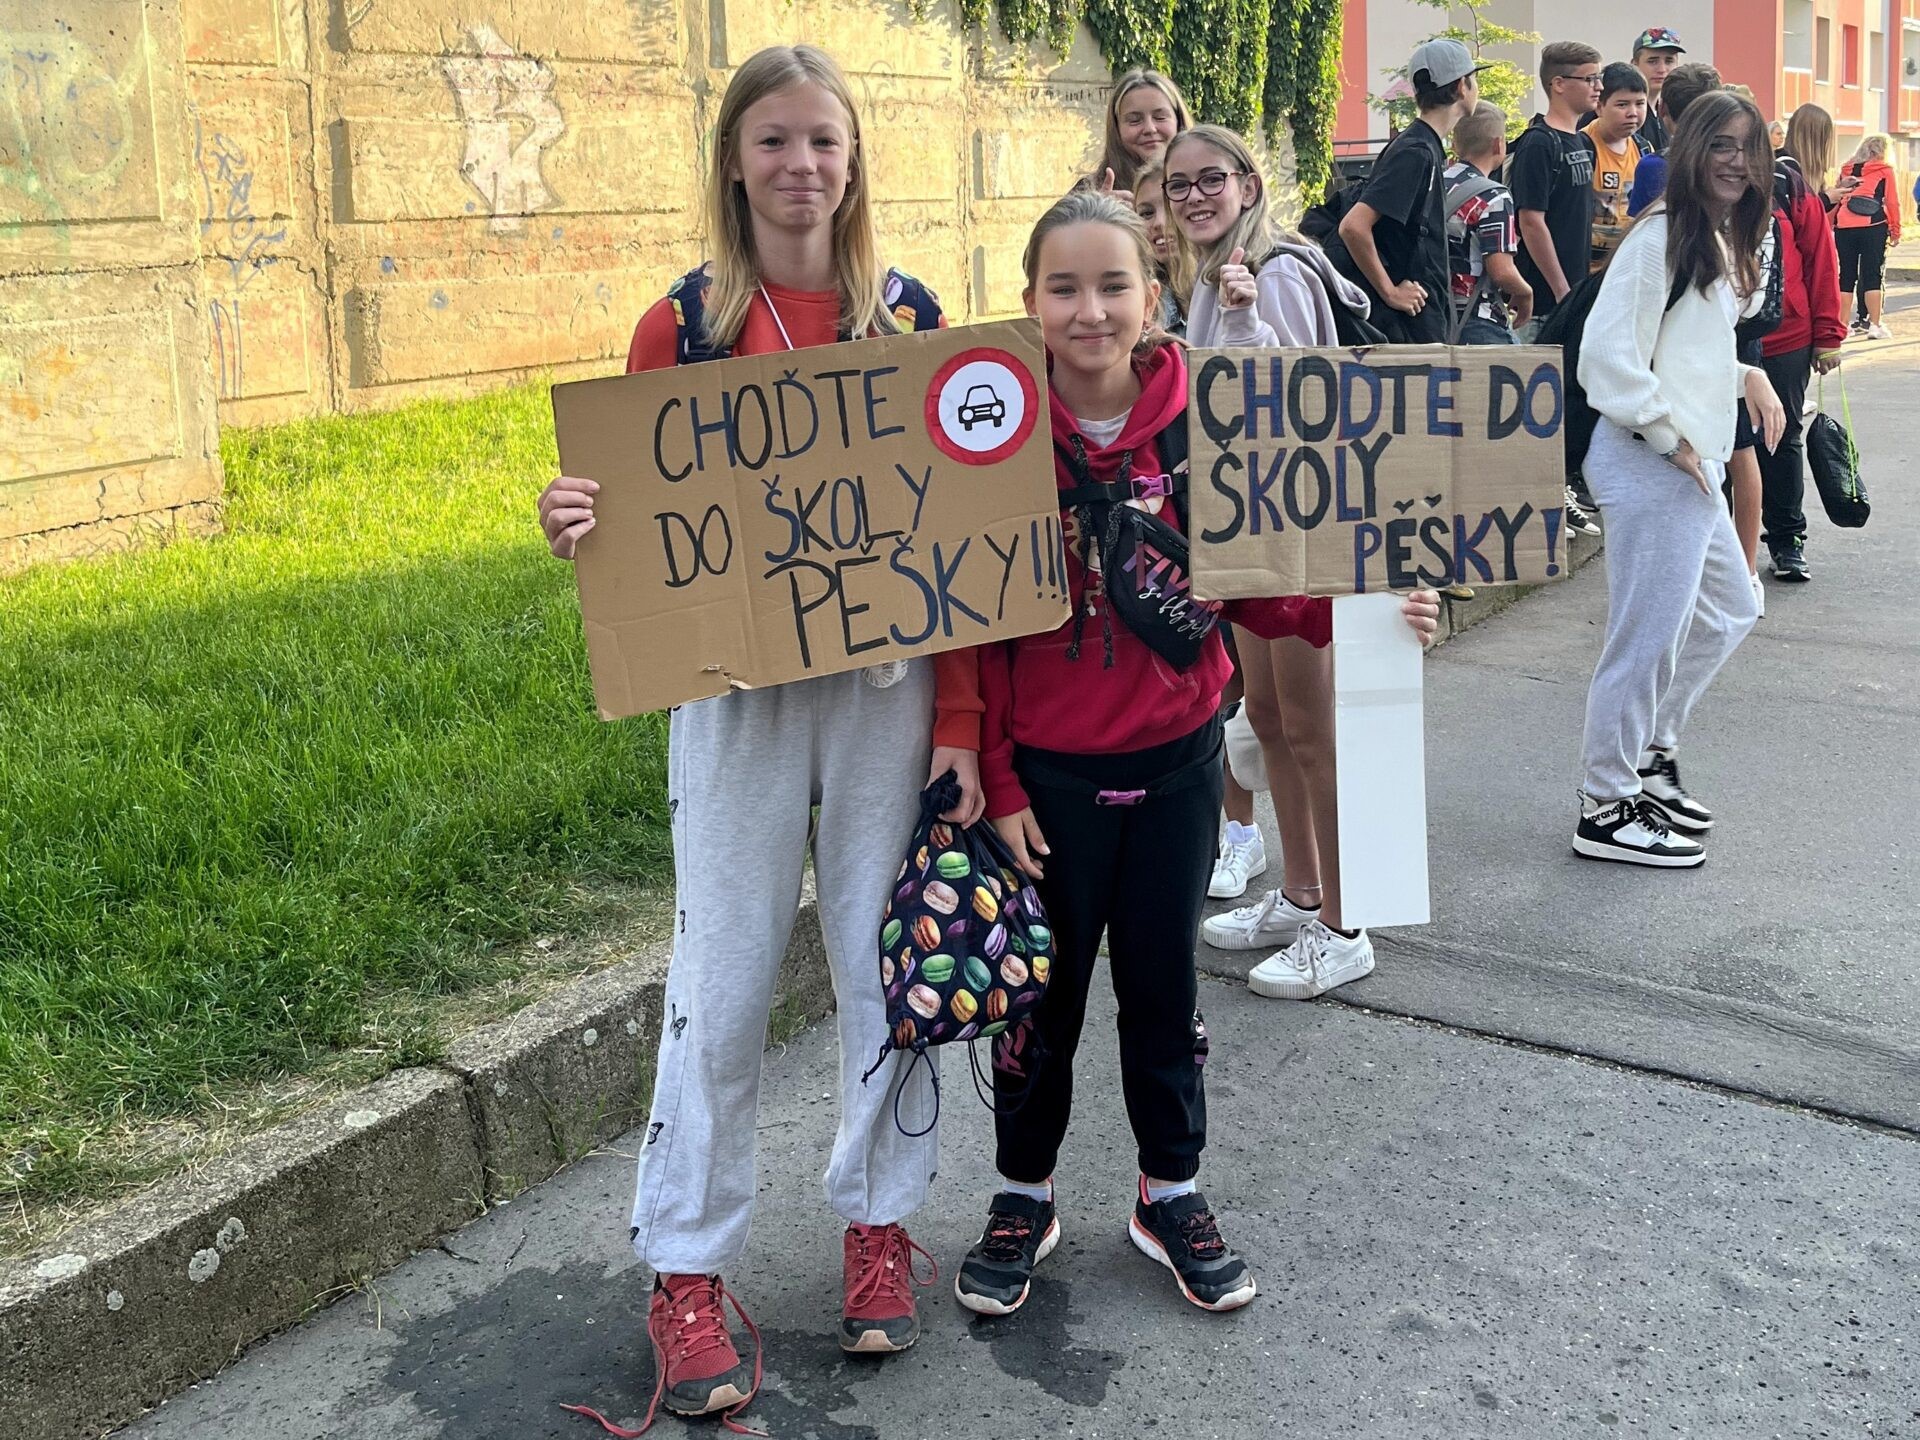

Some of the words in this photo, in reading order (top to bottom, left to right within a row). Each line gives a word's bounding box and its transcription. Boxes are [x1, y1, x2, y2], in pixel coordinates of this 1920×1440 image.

[653, 366, 905, 482] CHOĎTE
[1196, 348, 1463, 443] CHOĎTE
[1487, 362, 1564, 440] DO
[654, 503, 733, 588] DO
[762, 463, 932, 564] ŠKOLY
[1200, 431, 1393, 544] ŠKOLY
[1354, 493, 1563, 594] PĚŠKY!
